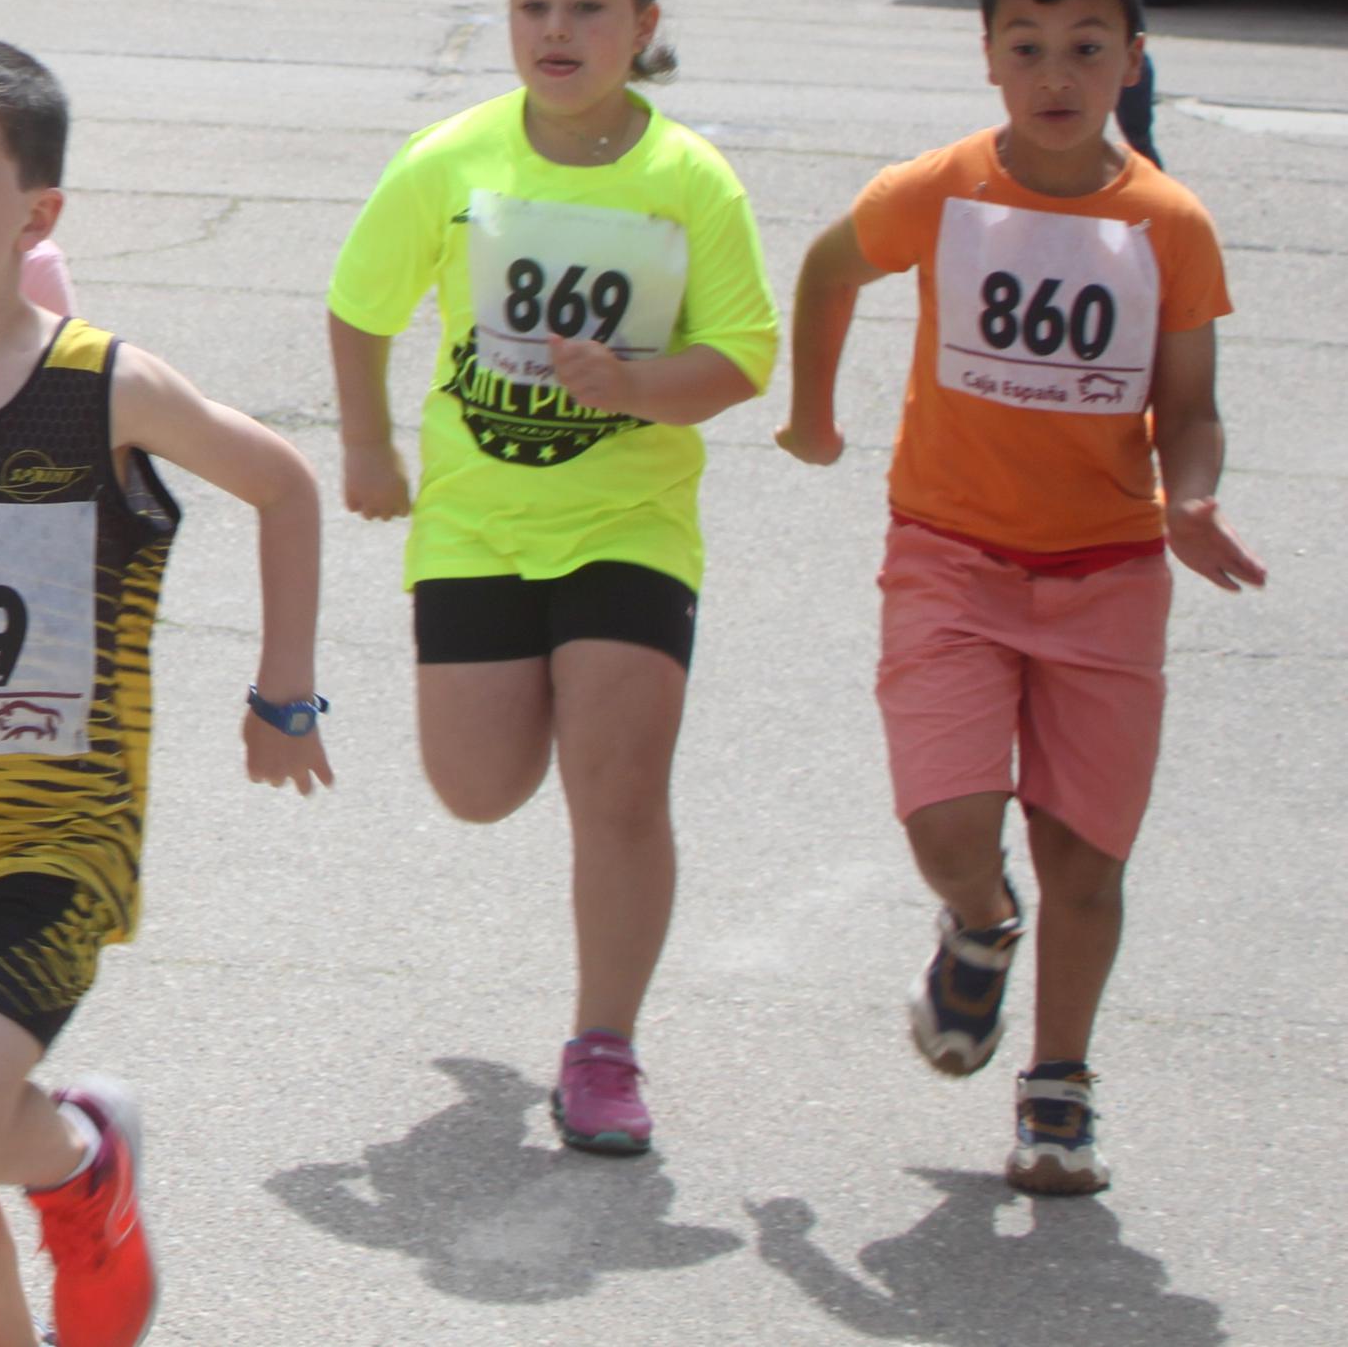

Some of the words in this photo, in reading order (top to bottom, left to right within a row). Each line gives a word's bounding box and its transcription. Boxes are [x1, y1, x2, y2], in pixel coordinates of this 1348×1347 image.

[506, 258, 631, 344] 869
[979, 270, 1116, 361] 860
[961, 371, 997, 395] Caja
[1002, 380, 1068, 404] España
